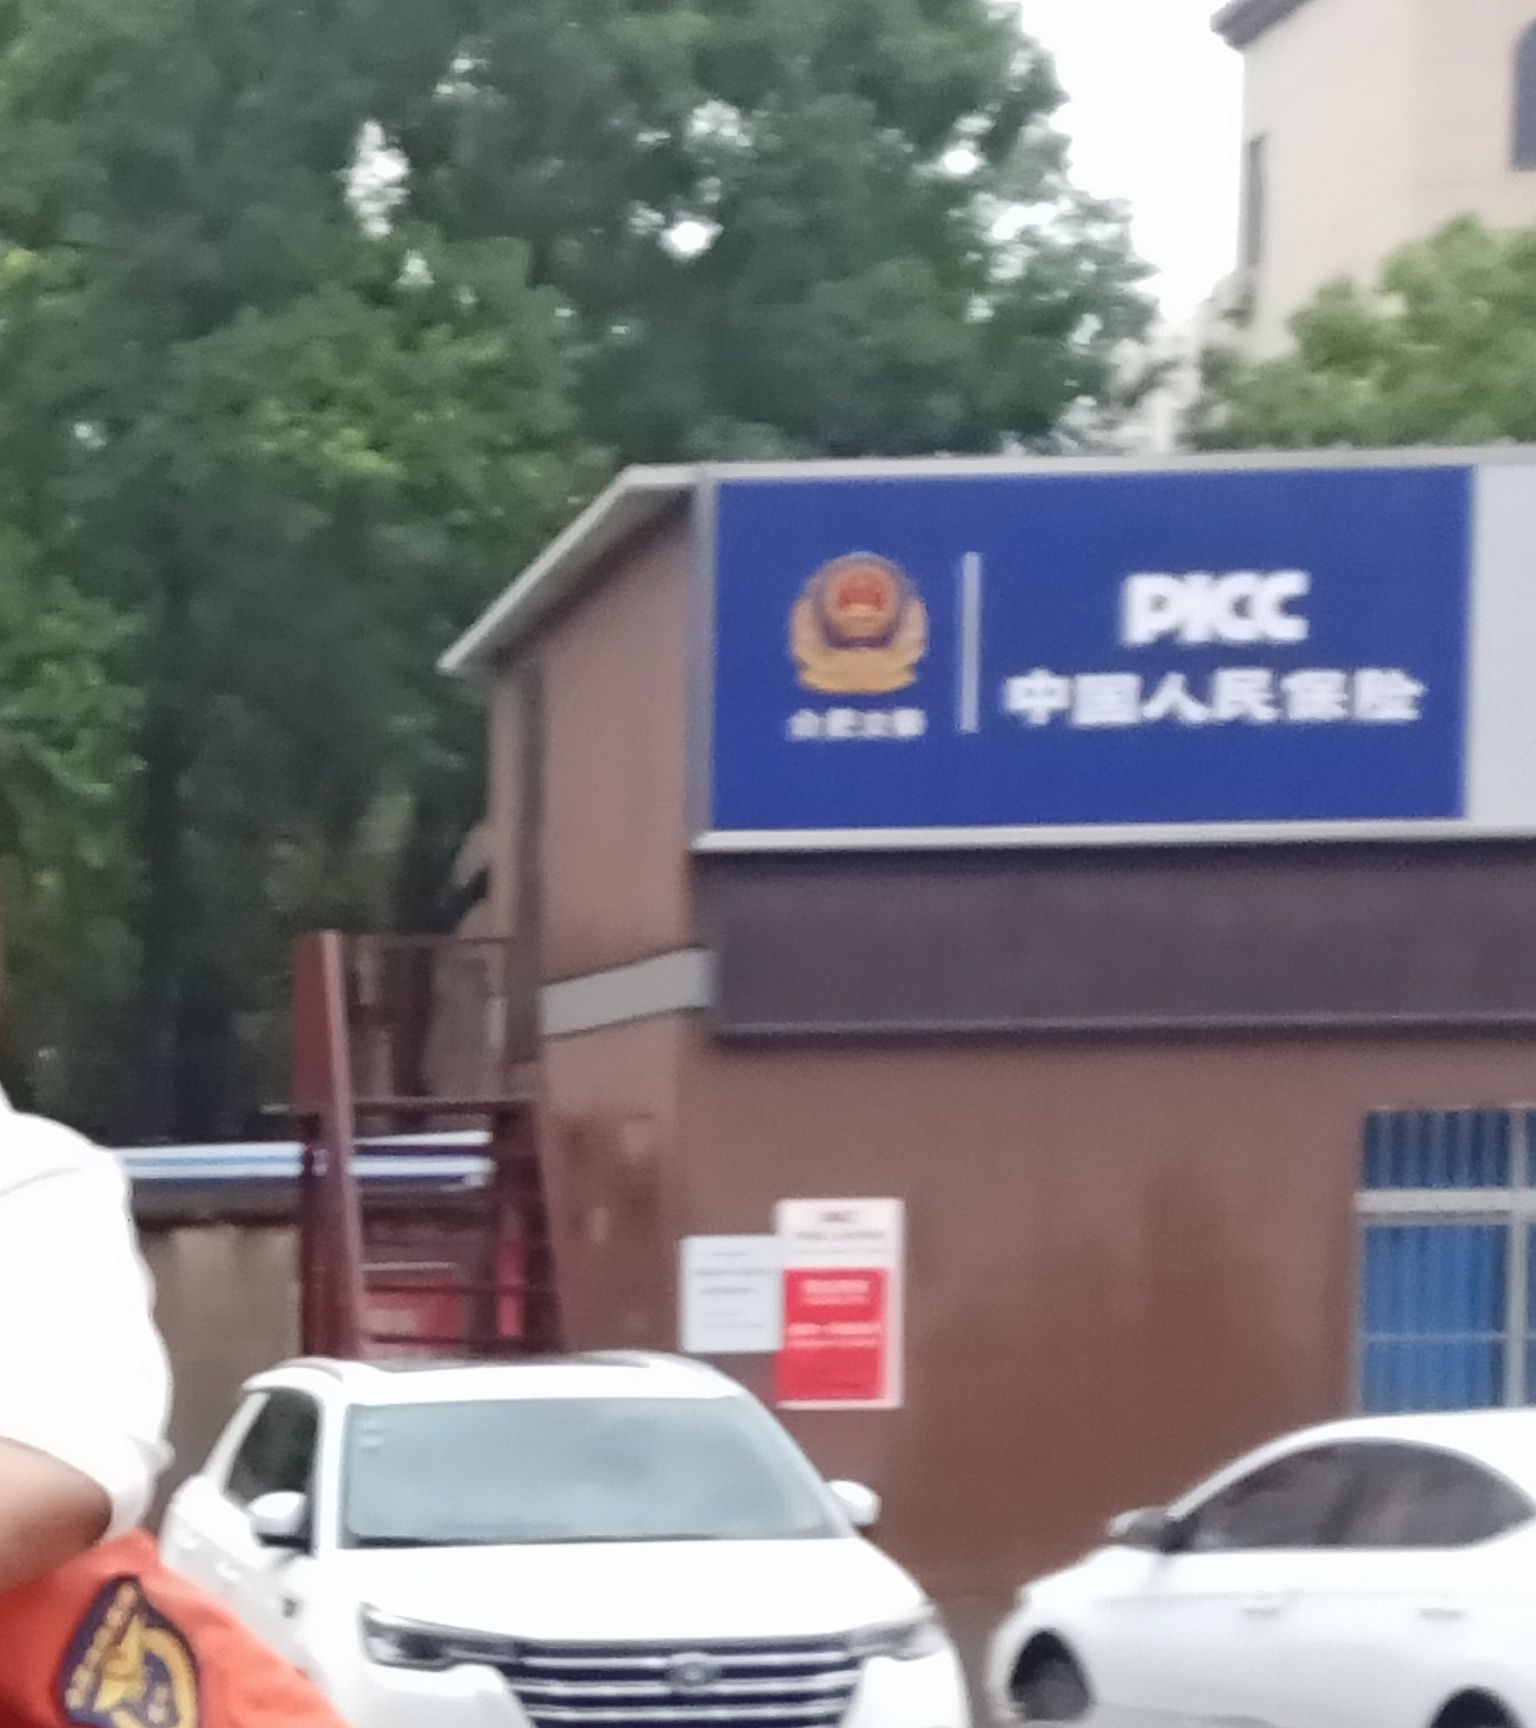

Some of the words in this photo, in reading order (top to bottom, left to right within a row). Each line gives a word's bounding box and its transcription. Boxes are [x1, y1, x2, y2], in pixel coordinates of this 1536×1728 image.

[1125, 571, 1308, 645] PICC
[1005, 668, 1426, 727] 中国人民保险
